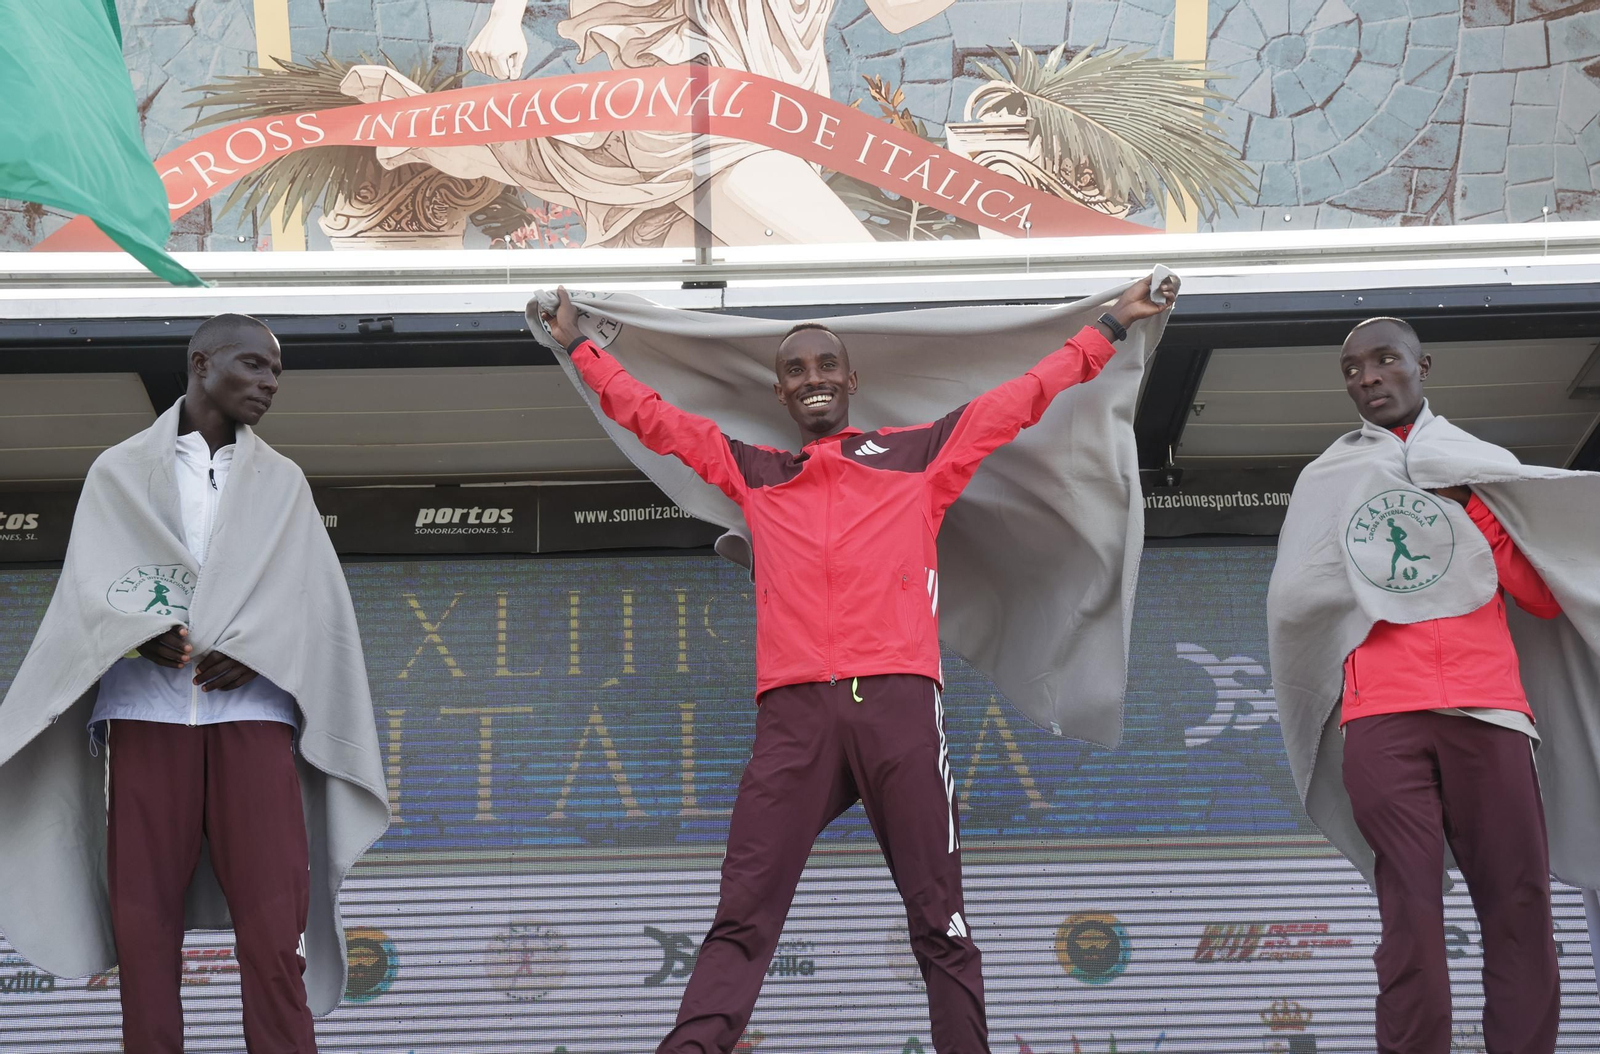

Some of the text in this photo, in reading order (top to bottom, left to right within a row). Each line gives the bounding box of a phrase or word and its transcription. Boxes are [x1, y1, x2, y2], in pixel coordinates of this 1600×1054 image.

[158, 76, 1034, 230] CROSS INTERNACIONAL DE ITÁLICA
[415, 506, 514, 527] portos
[574, 503, 696, 524] www.sonorizacio
[1354, 494, 1438, 543] ITÁLICA
[1368, 509, 1425, 541] CROSS INTERNACIONAL
[414, 527, 499, 535] SONORIZACIONES,
